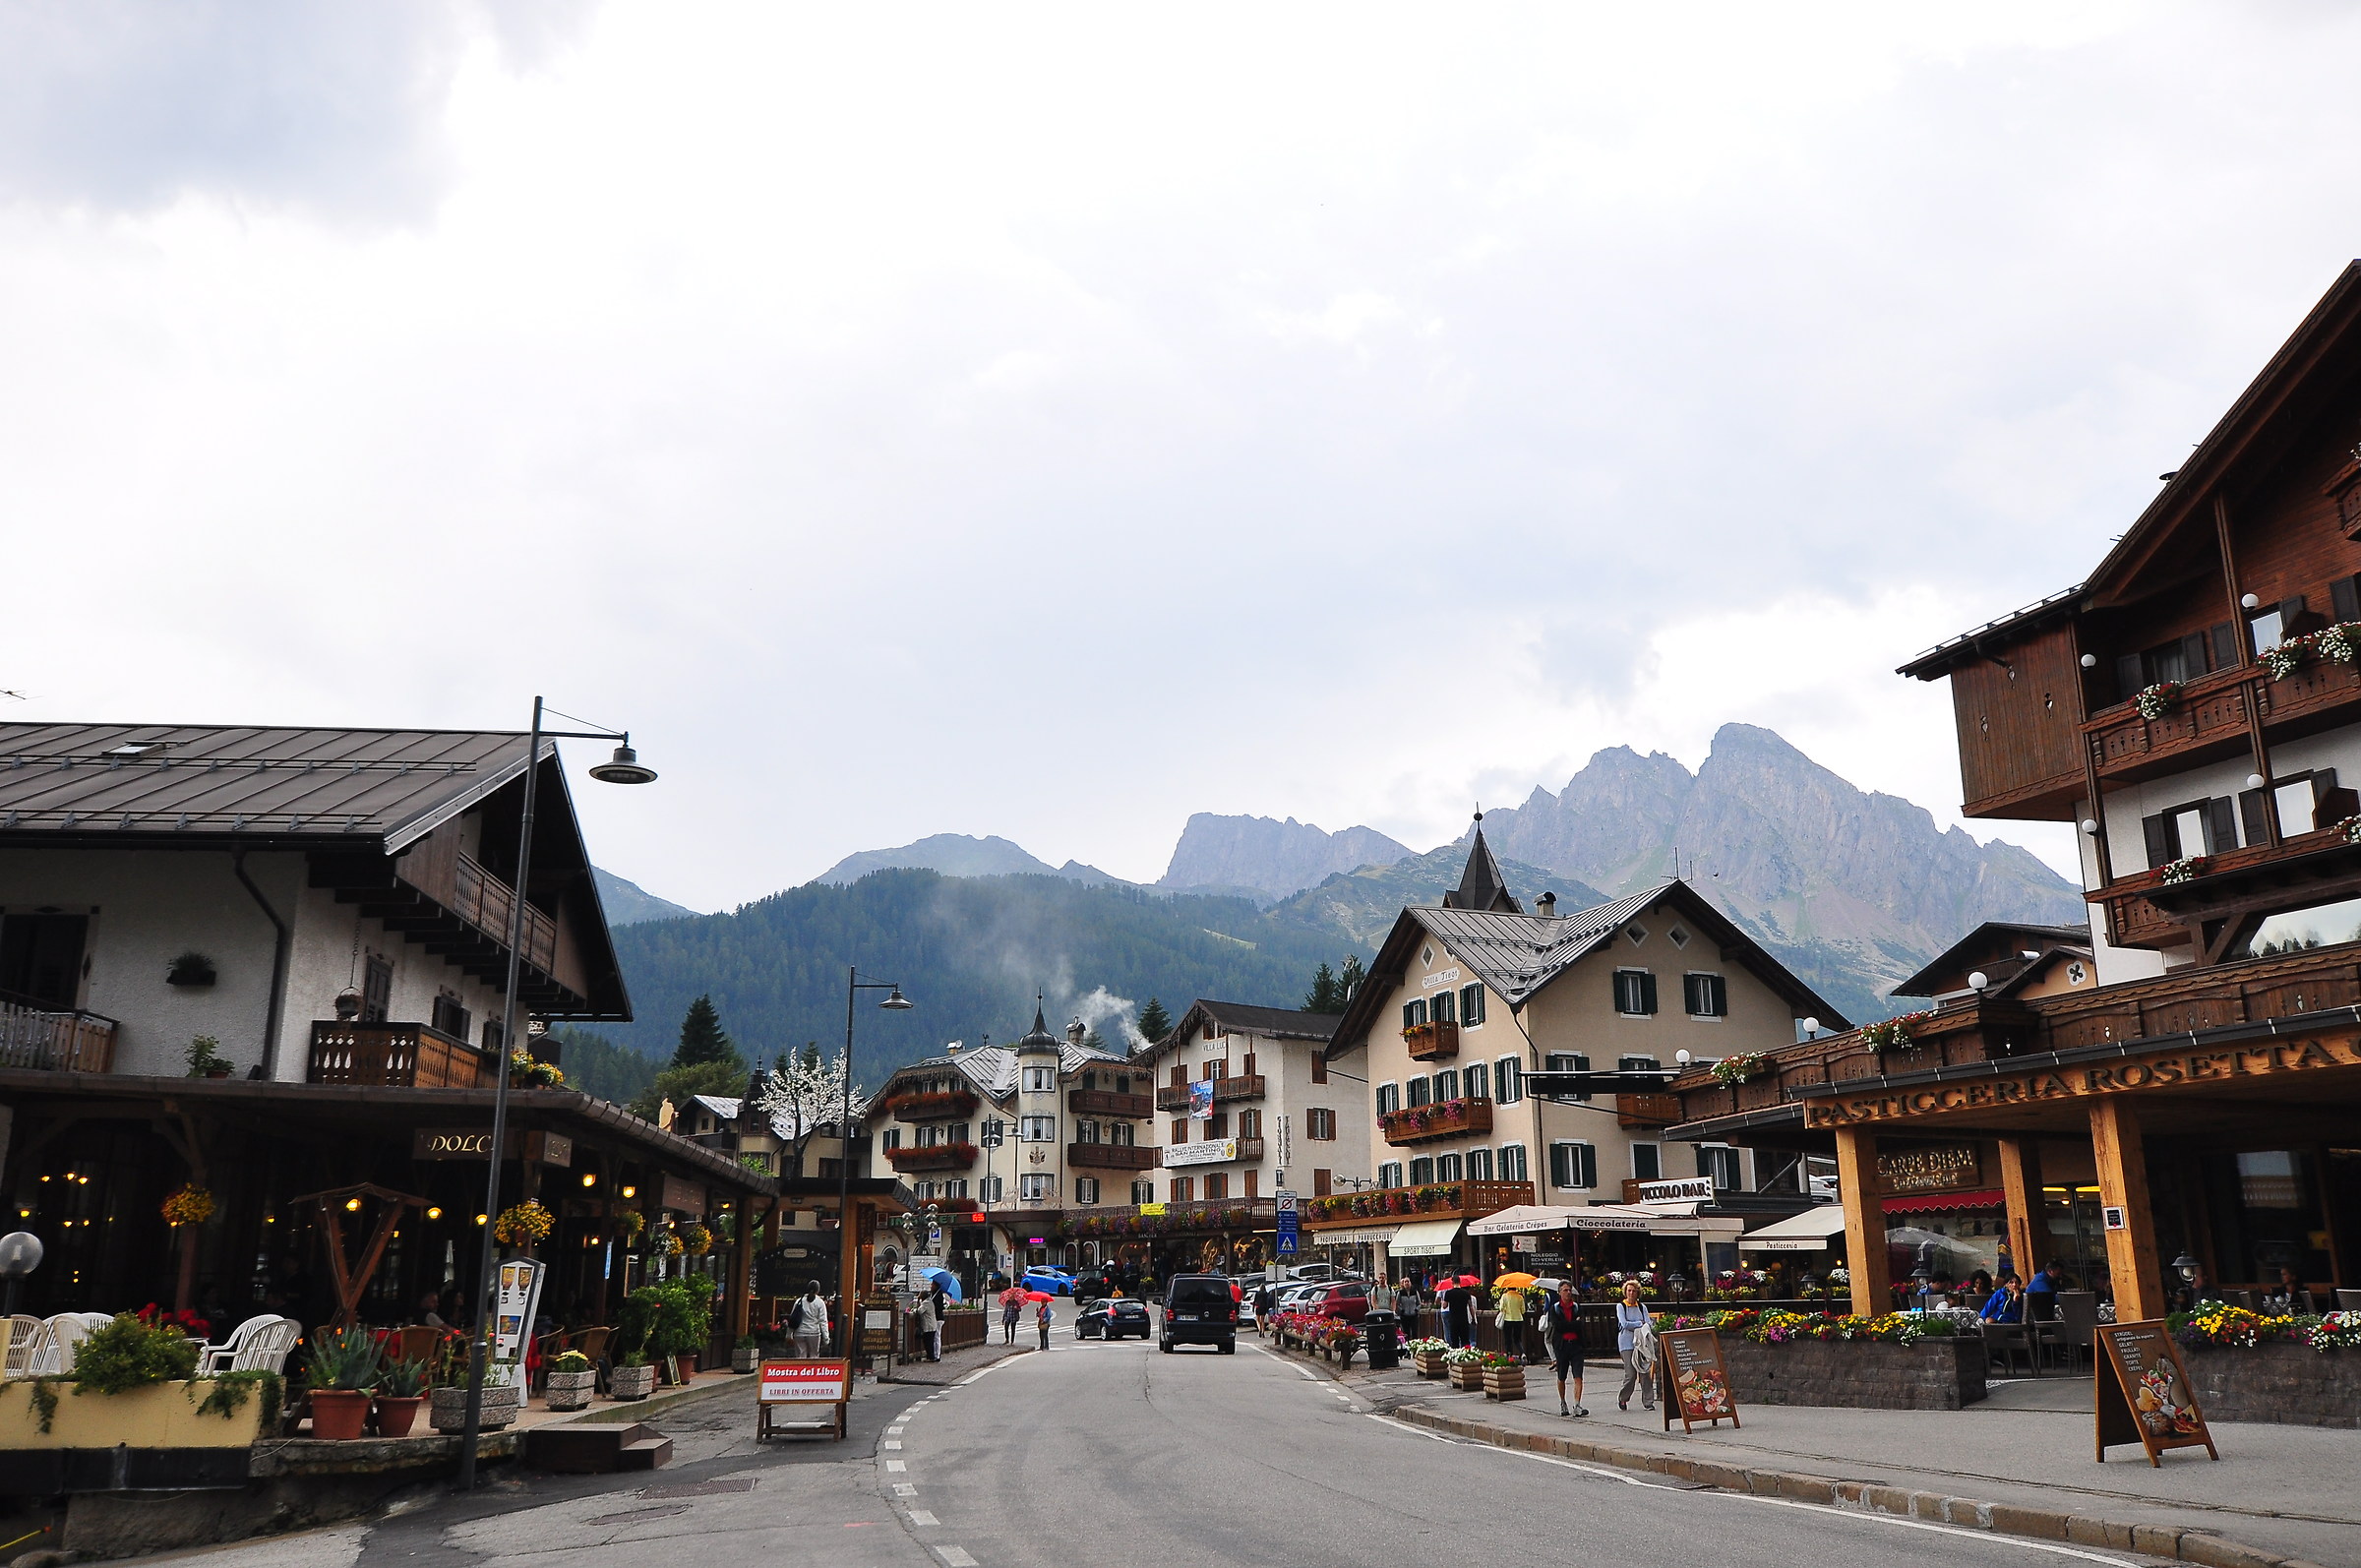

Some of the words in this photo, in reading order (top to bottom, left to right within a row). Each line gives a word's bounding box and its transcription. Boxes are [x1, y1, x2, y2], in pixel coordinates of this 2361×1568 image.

[1202, 1043, 1215, 1052] VILLA
[1807, 1072, 2072, 1124] PASTICCERIA
[2082, 1039, 2339, 1092] ROSETTA
[1877, 1154, 1925, 1176] CARPE
[1928, 1149, 1973, 1172] DIEM
[1639, 1184, 1681, 1201] PICCOLO
[1681, 1182, 1707, 1197] BAR
[1496, 1223, 1524, 1232] Gelateria
[1576, 1219, 1646, 1229] Cioccolateria
[800, 1367, 815, 1376] del
[817, 1366, 840, 1376] Libro
